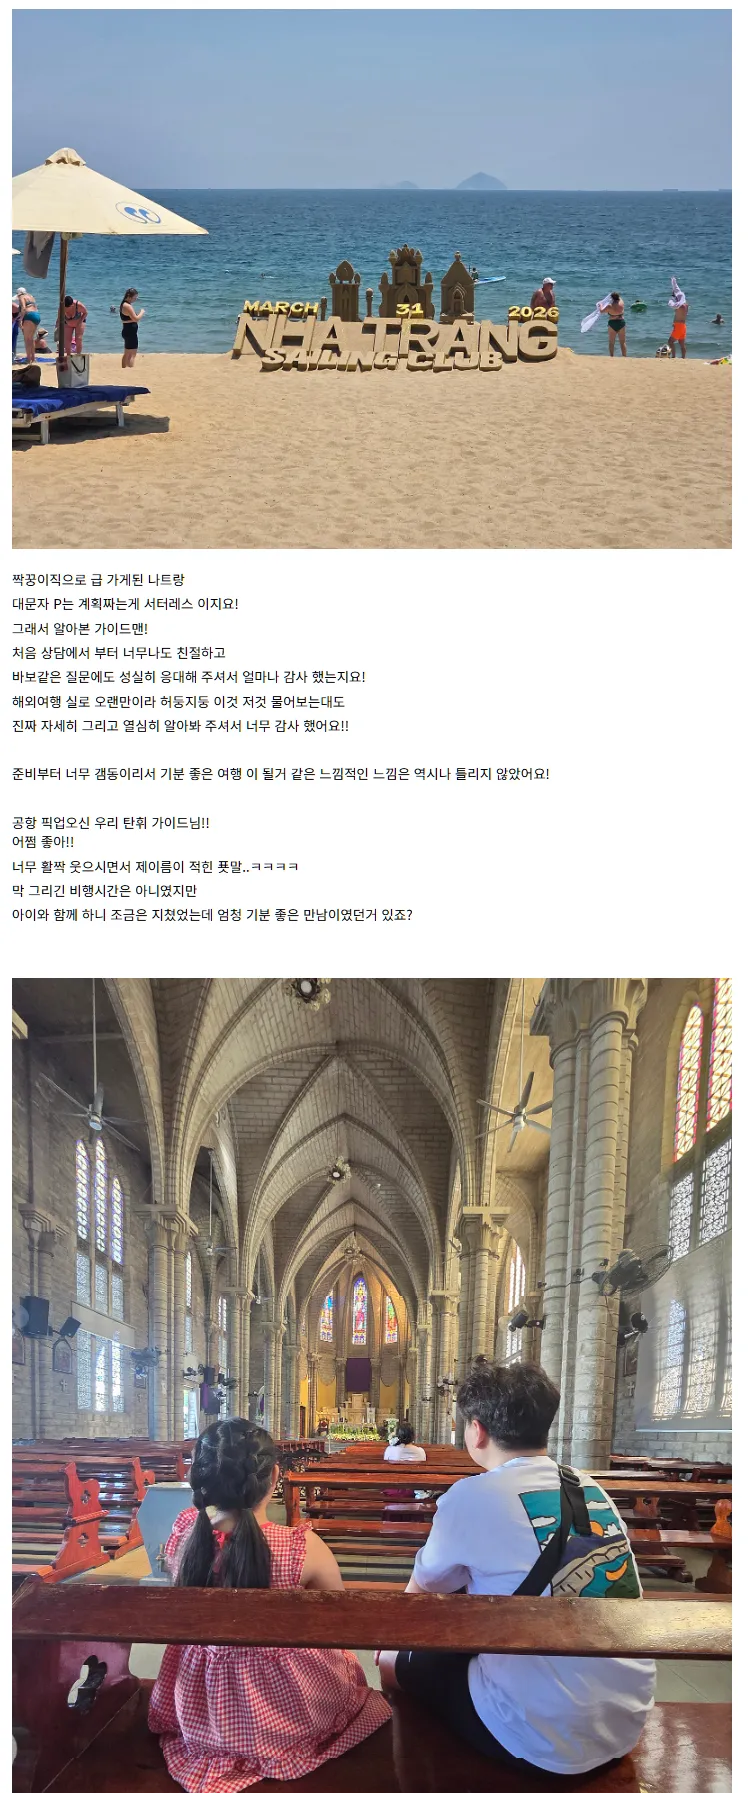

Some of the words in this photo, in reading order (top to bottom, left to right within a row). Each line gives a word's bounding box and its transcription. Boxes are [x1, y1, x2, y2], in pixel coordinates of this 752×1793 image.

[243, 300, 319, 316] MARCH
[395, 303, 424, 319] 31
[508, 306, 560, 323] 2026
[231, 312, 343, 360] NHA
[361, 316, 558, 362] TRANG
[260, 349, 398, 372] SAILING
[406, 351, 502, 372] CLUB
